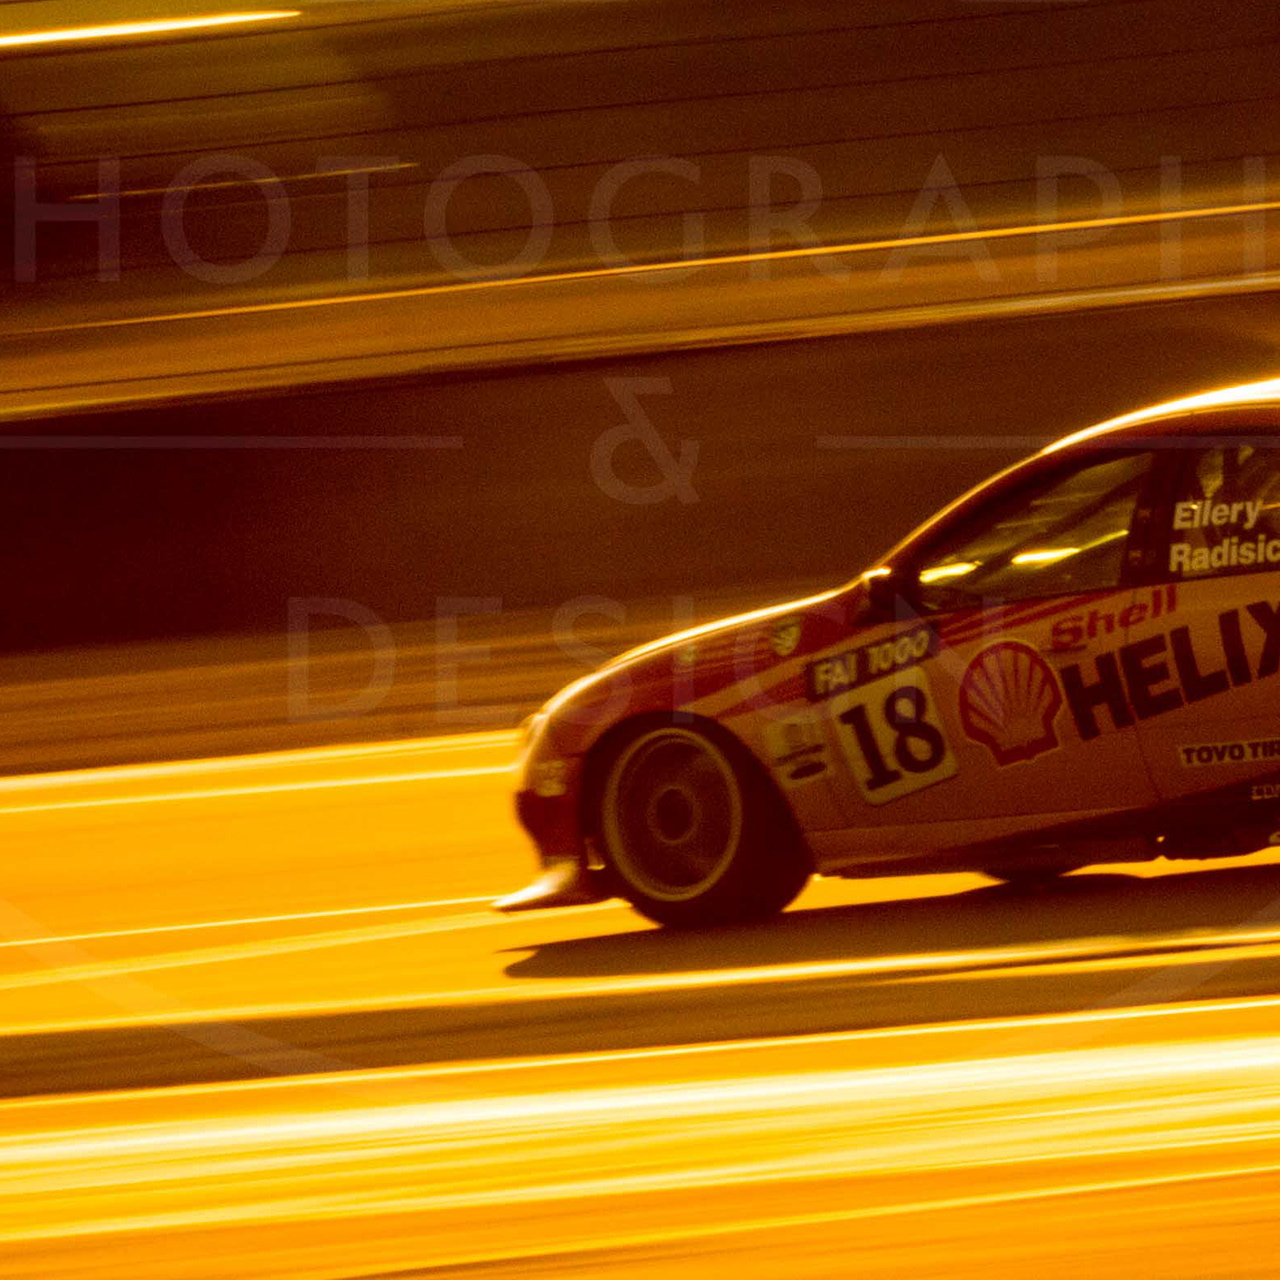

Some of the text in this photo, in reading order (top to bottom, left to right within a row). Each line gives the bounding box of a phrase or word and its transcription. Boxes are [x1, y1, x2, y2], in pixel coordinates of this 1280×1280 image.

[1052, 584, 1177, 648] Shell
[814, 631, 930, 695] FAI 1000
[839, 685, 946, 791] 18
[1182, 743, 1245, 764] TOYO
